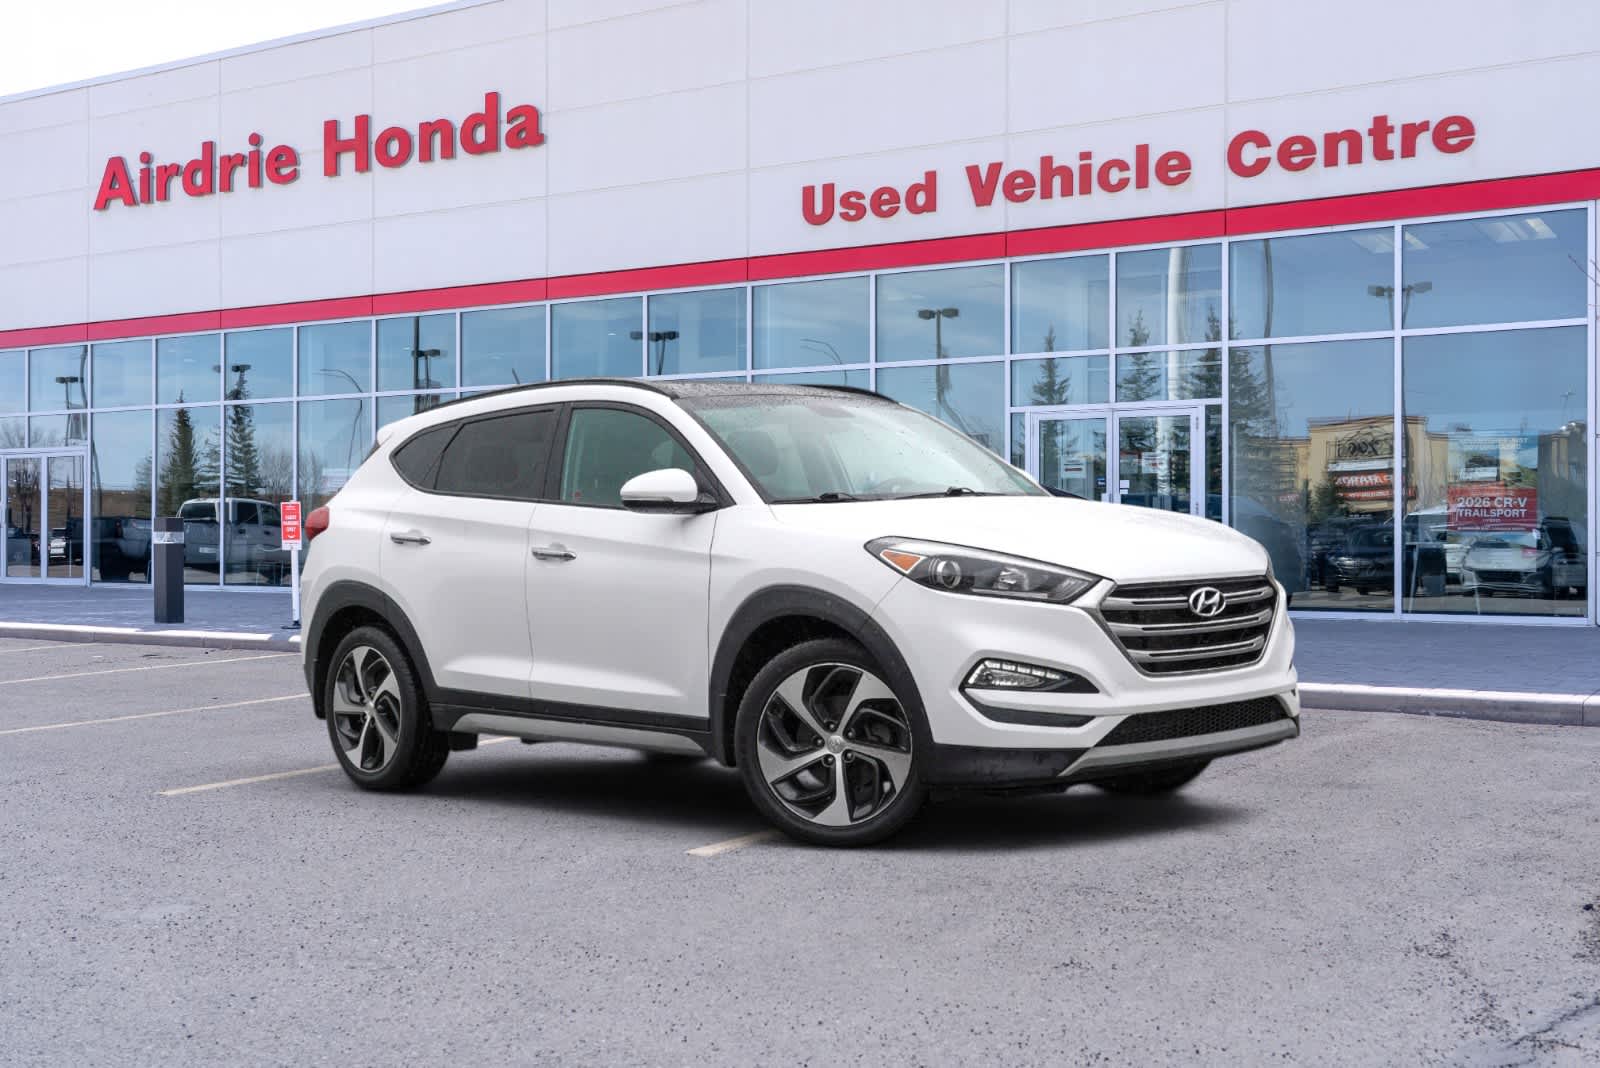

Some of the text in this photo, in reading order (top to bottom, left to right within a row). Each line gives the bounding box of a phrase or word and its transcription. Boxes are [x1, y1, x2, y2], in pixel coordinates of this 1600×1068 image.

[94, 91, 546, 211] Airdrie Honda
[801, 114, 1476, 226] Used Vehicle Centre
[1457, 497, 1527, 507] 2026 CR-V
[1458, 508, 1527, 517] TRAILSPORT
